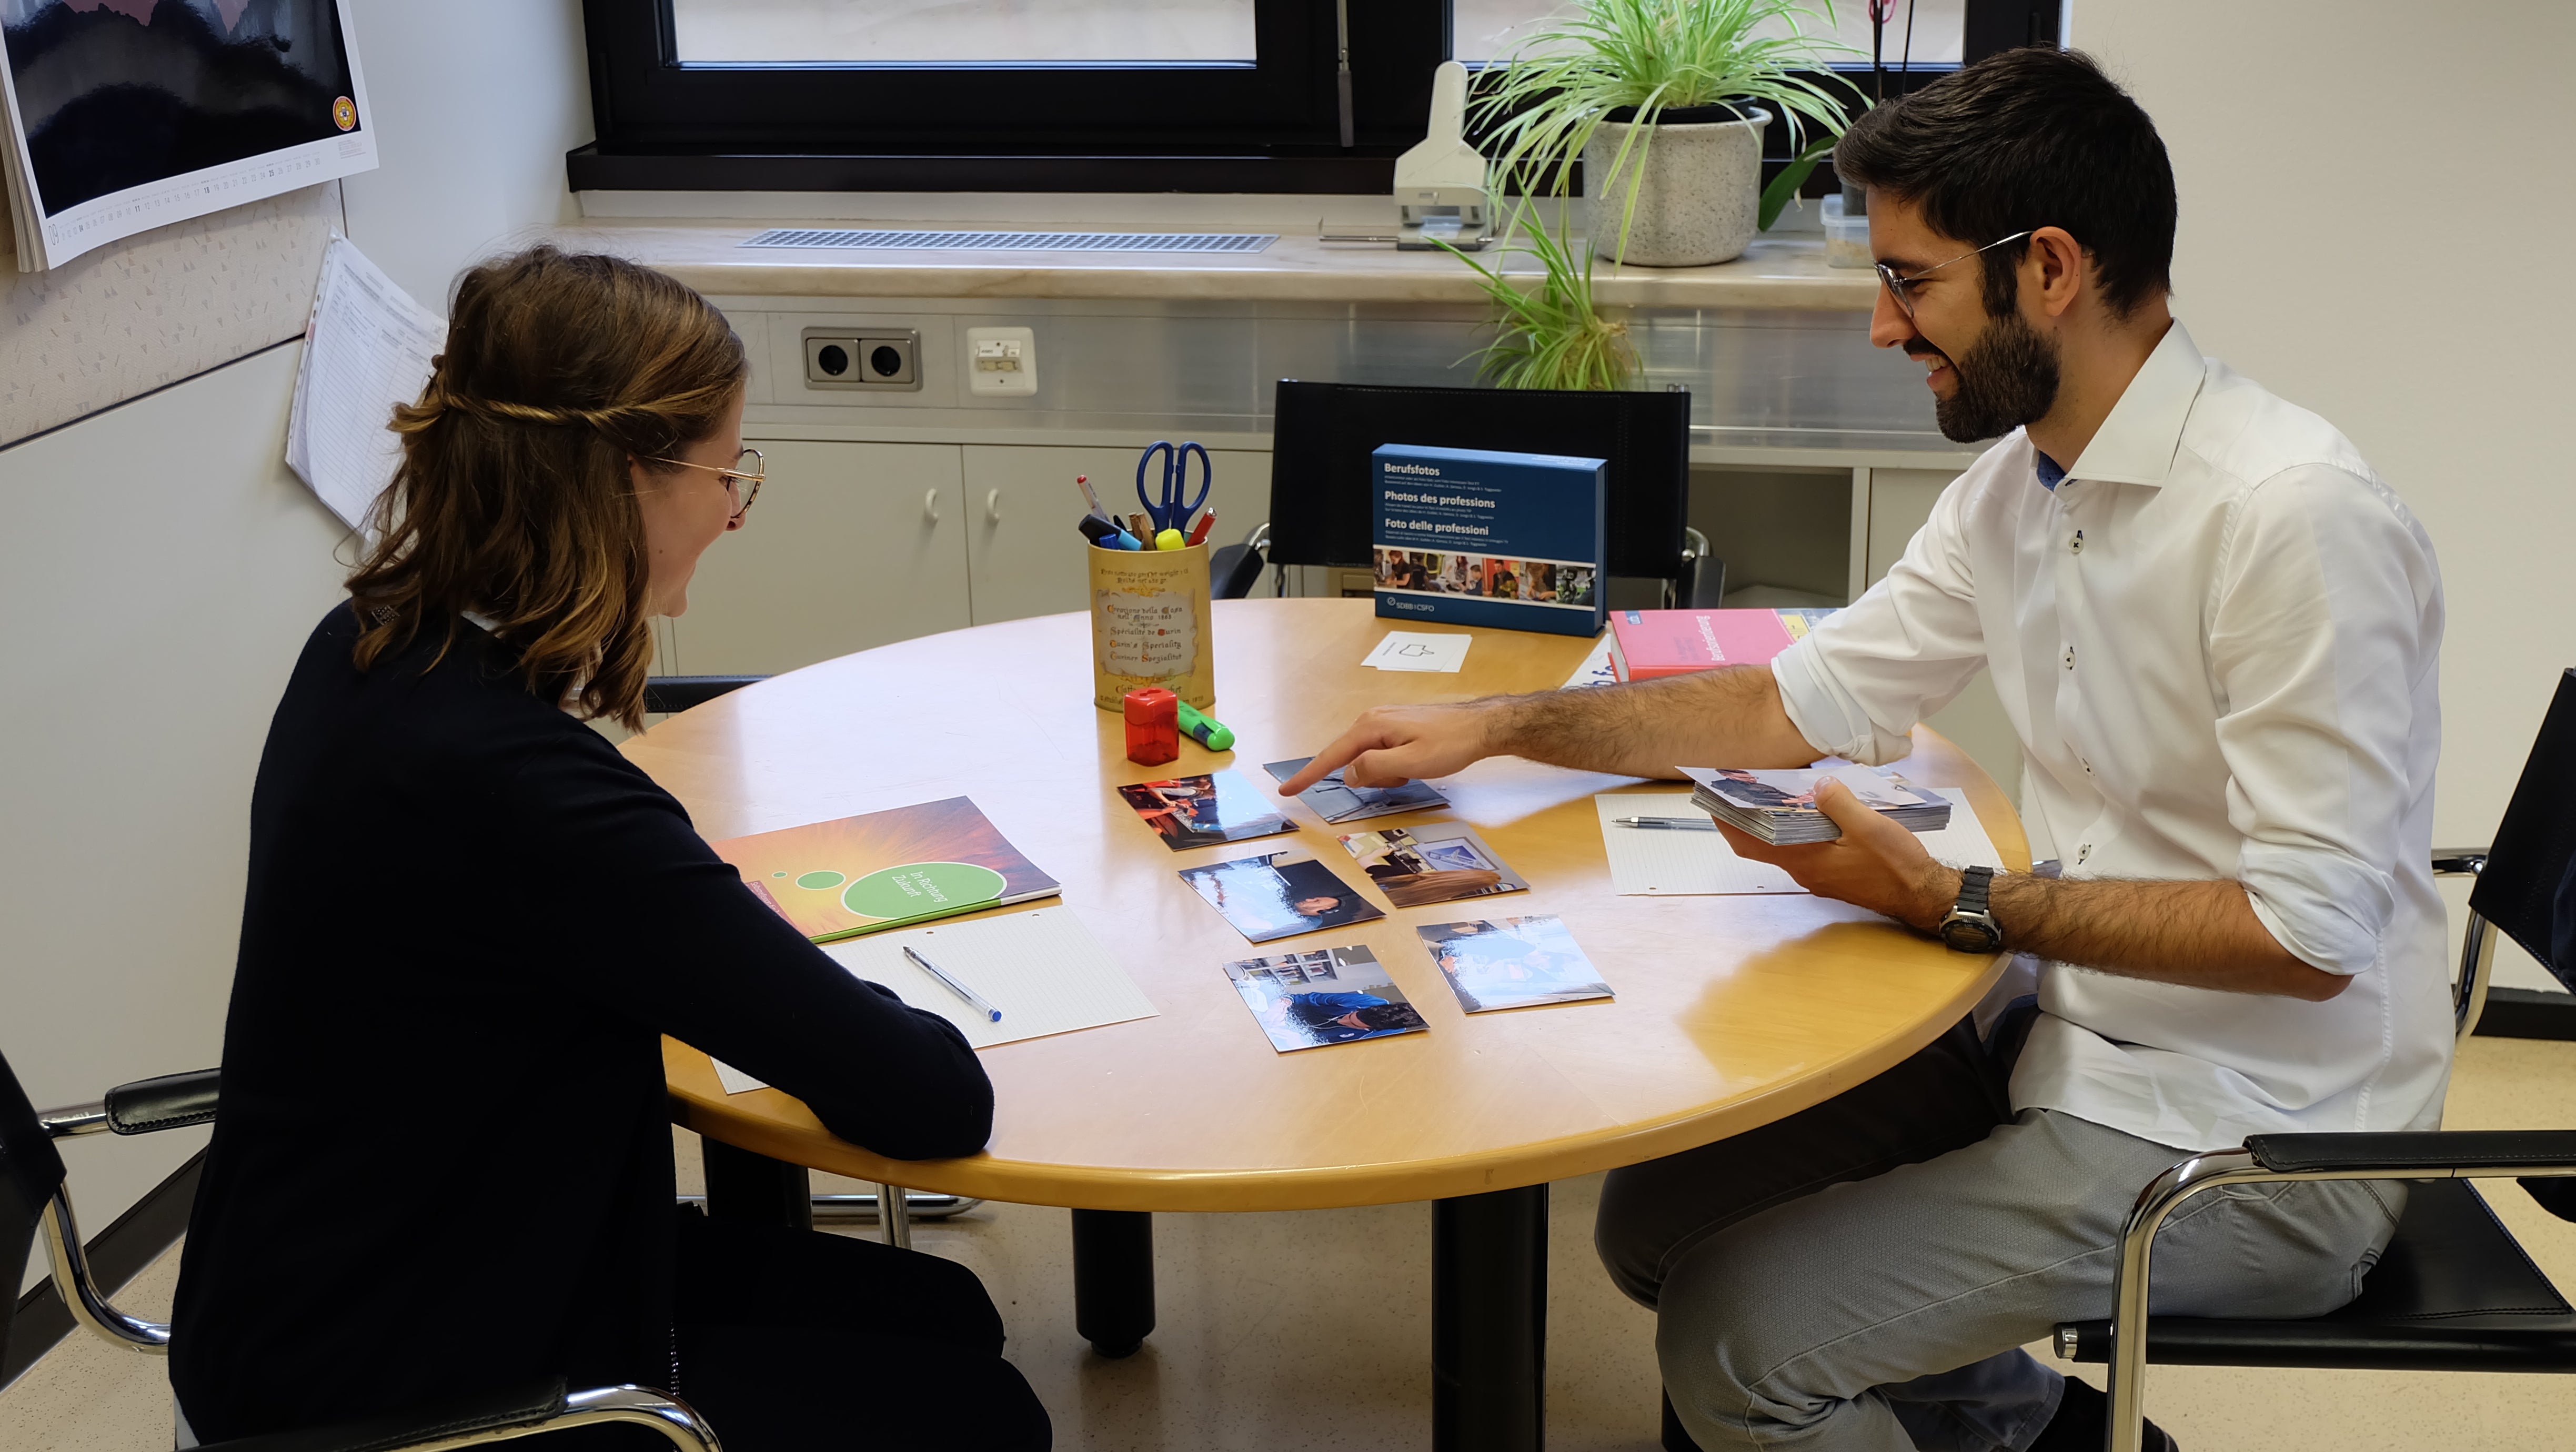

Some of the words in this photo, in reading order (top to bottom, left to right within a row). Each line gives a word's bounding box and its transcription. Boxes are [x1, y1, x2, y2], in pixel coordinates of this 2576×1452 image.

[48, 224, 59, 245] 09
[1384, 463, 1440, 476] Berufsfotos
[1384, 490, 1418, 502] Photos
[1420, 493, 1437, 503] des
[1440, 496, 1495, 509] professions
[1385, 518, 1407, 529] Foto
[1408, 520, 1433, 531] delle
[1435, 523, 1489, 536] professioni
[1696, 615, 1726, 661] Berufsorientierung
[892, 874, 922, 898] Zukunft
[917, 878, 948, 902] Richtung
